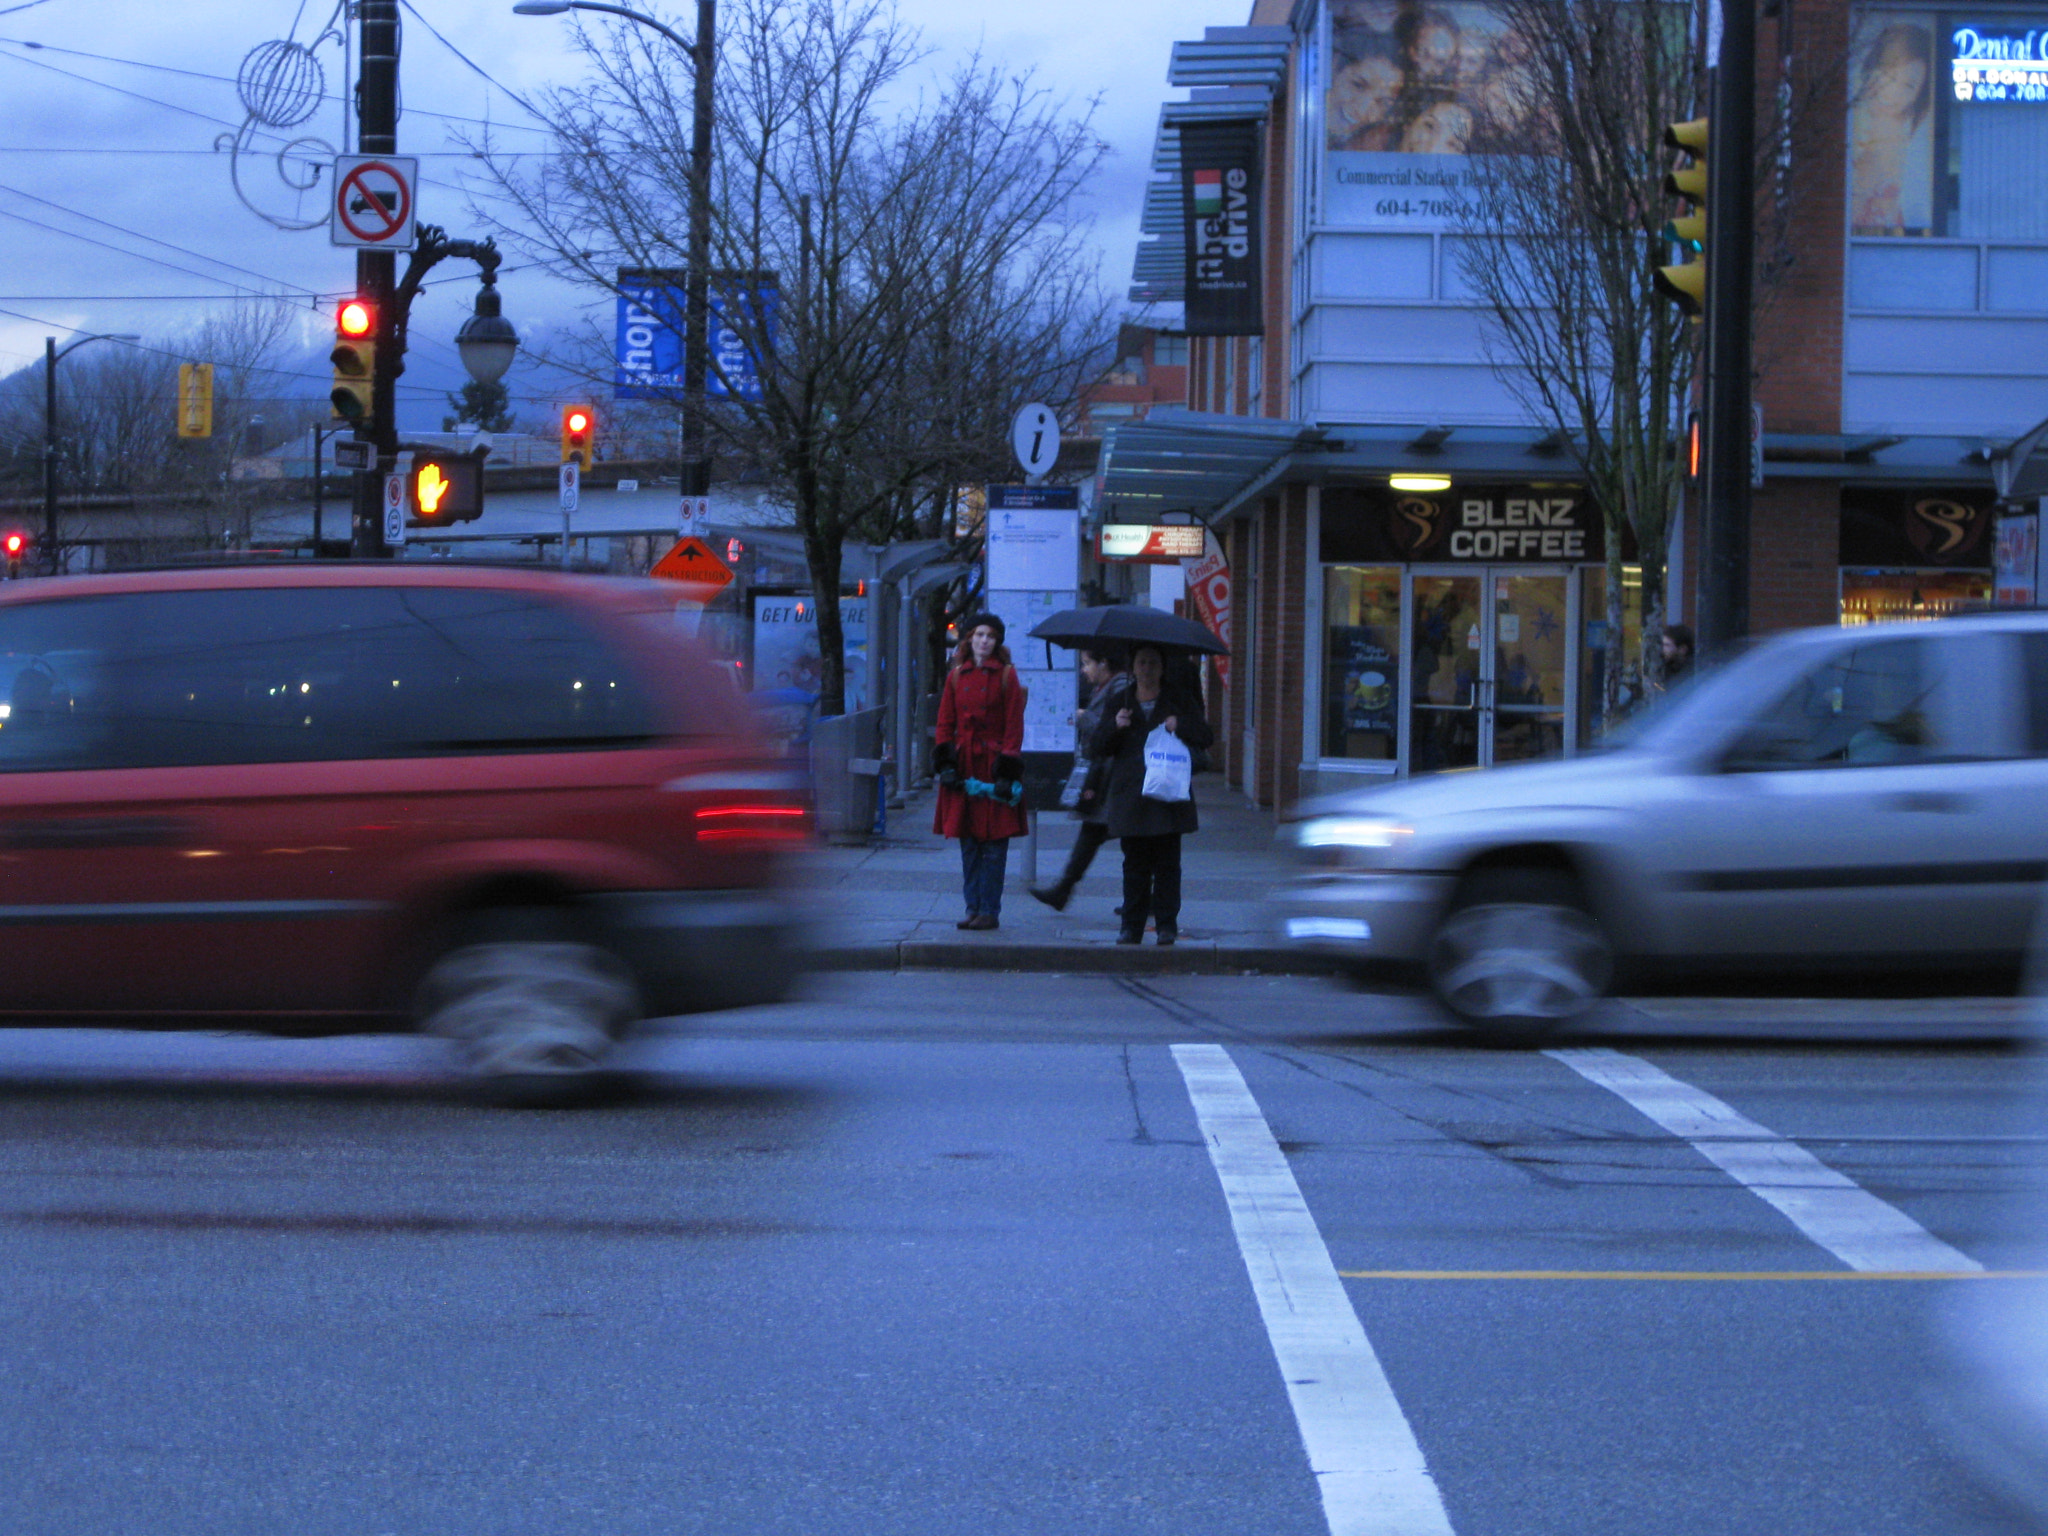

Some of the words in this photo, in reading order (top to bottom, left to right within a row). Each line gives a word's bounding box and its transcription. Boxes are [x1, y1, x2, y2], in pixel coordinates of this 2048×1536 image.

[1953, 28, 2036, 60] Dental
[1336, 167, 1412, 185] Commercial
[1221, 167, 1249, 259] drive
[1462, 499, 1575, 526] BLENZ
[1451, 530, 1586, 558] COFFEE
[654, 569, 727, 581] CONSTRUCTION
[762, 607, 791, 623] GET
